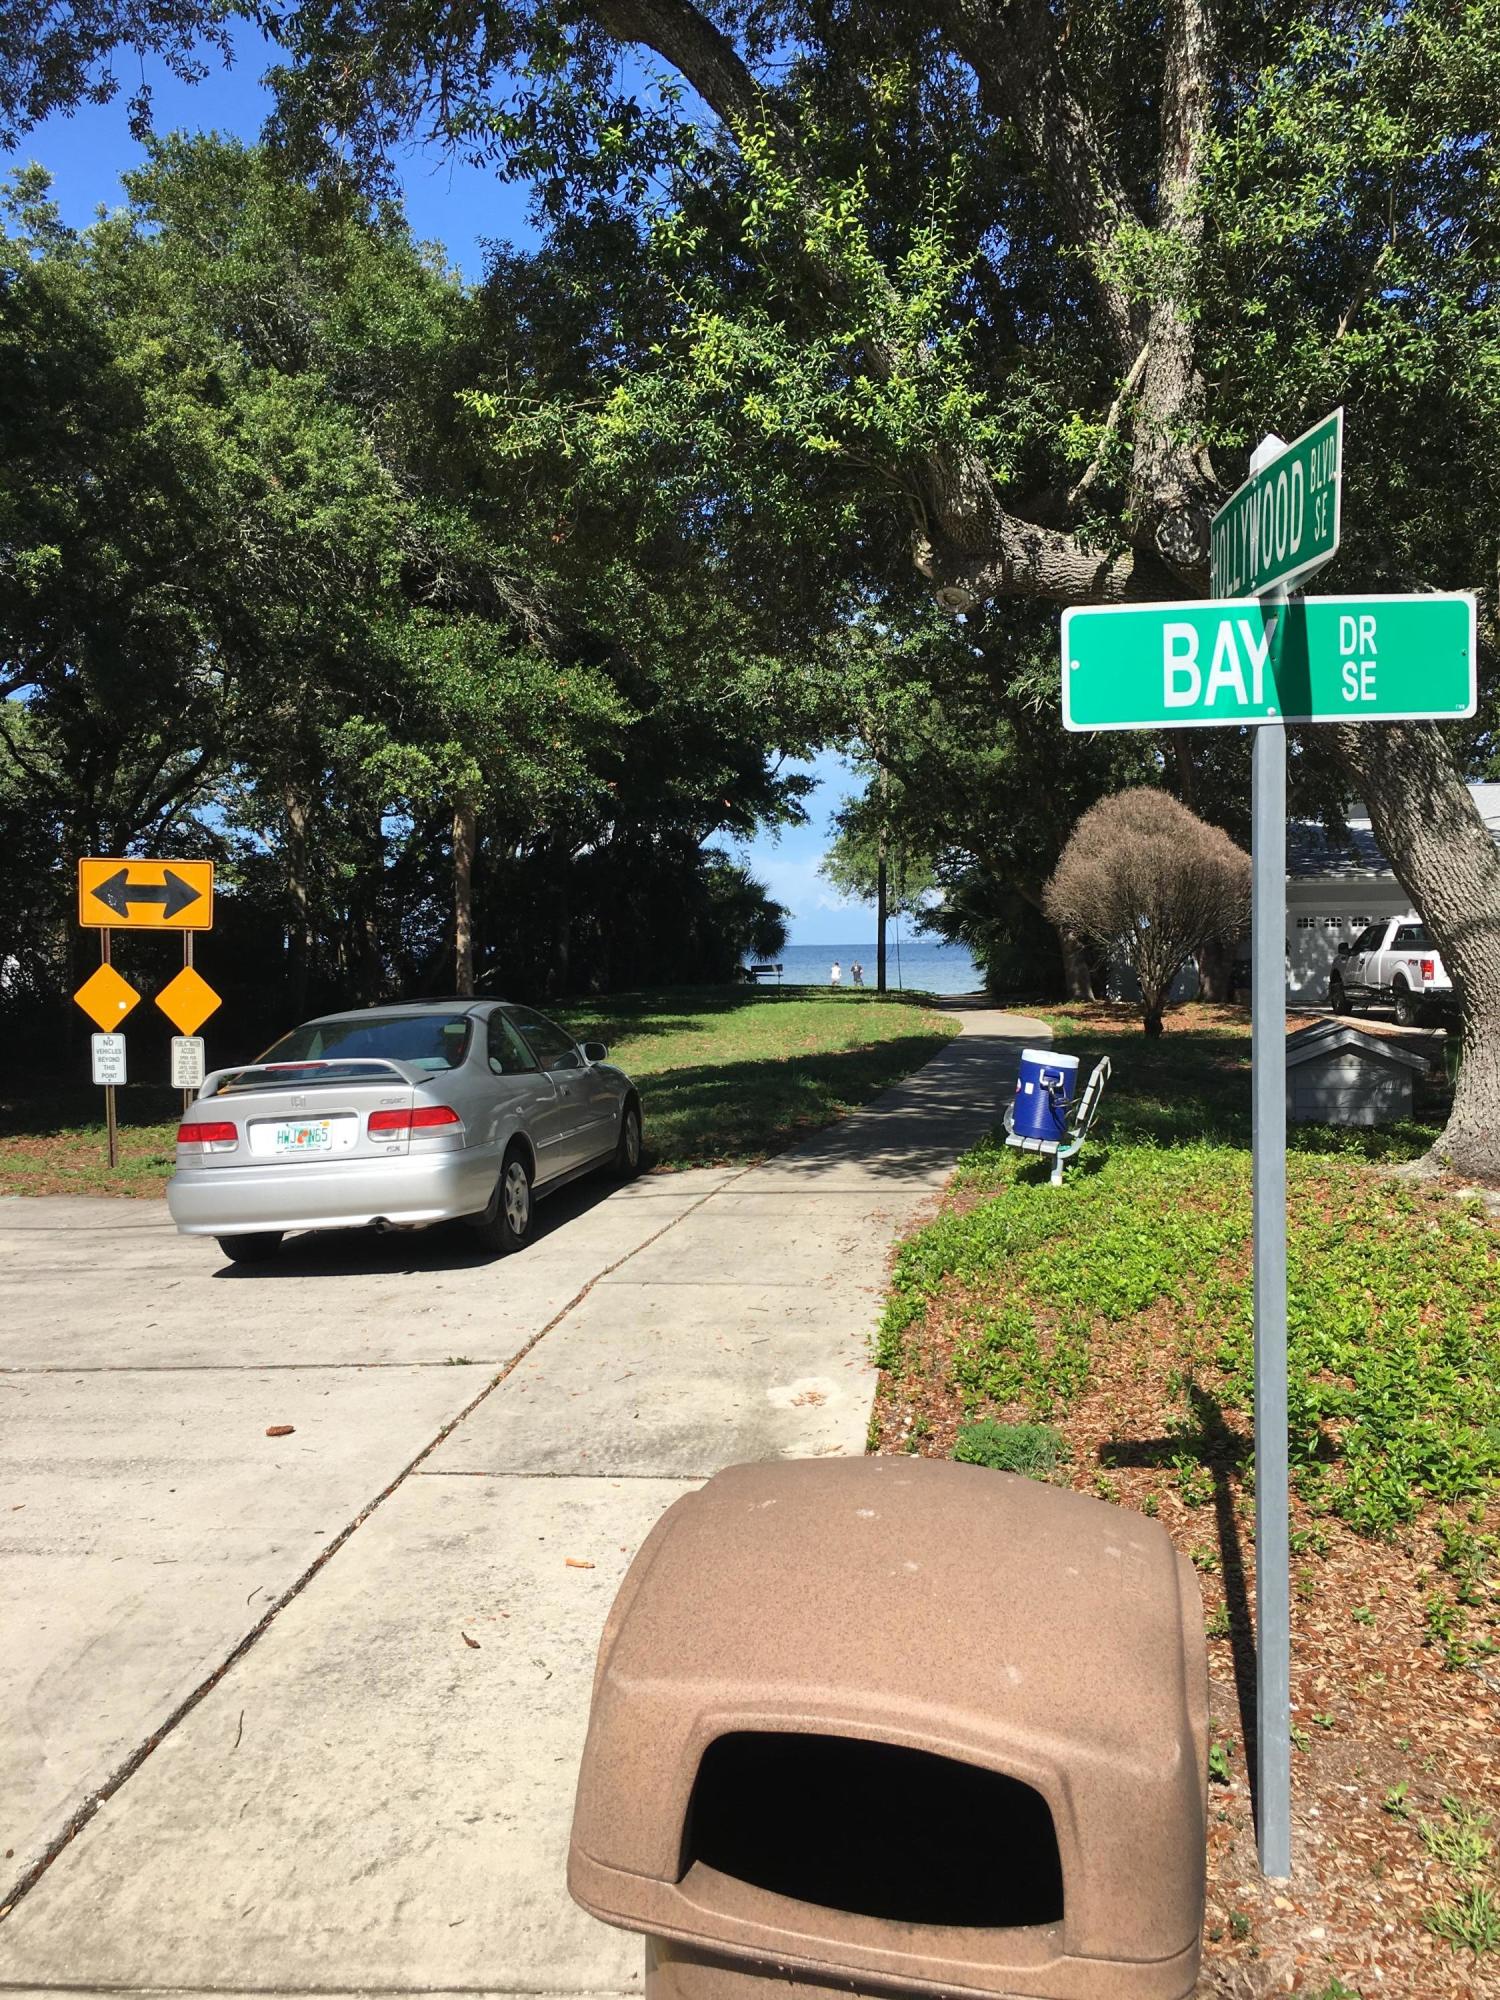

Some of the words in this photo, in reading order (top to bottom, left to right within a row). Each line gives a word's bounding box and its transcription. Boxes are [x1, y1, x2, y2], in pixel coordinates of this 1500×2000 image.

[1212, 460, 1304, 599] HOLLYWOOD
[1314, 492, 1328, 541] SE
[1163, 619, 1278, 708] BAY
[1339, 615, 1378, 655] DR
[1341, 661, 1377, 702] SE
